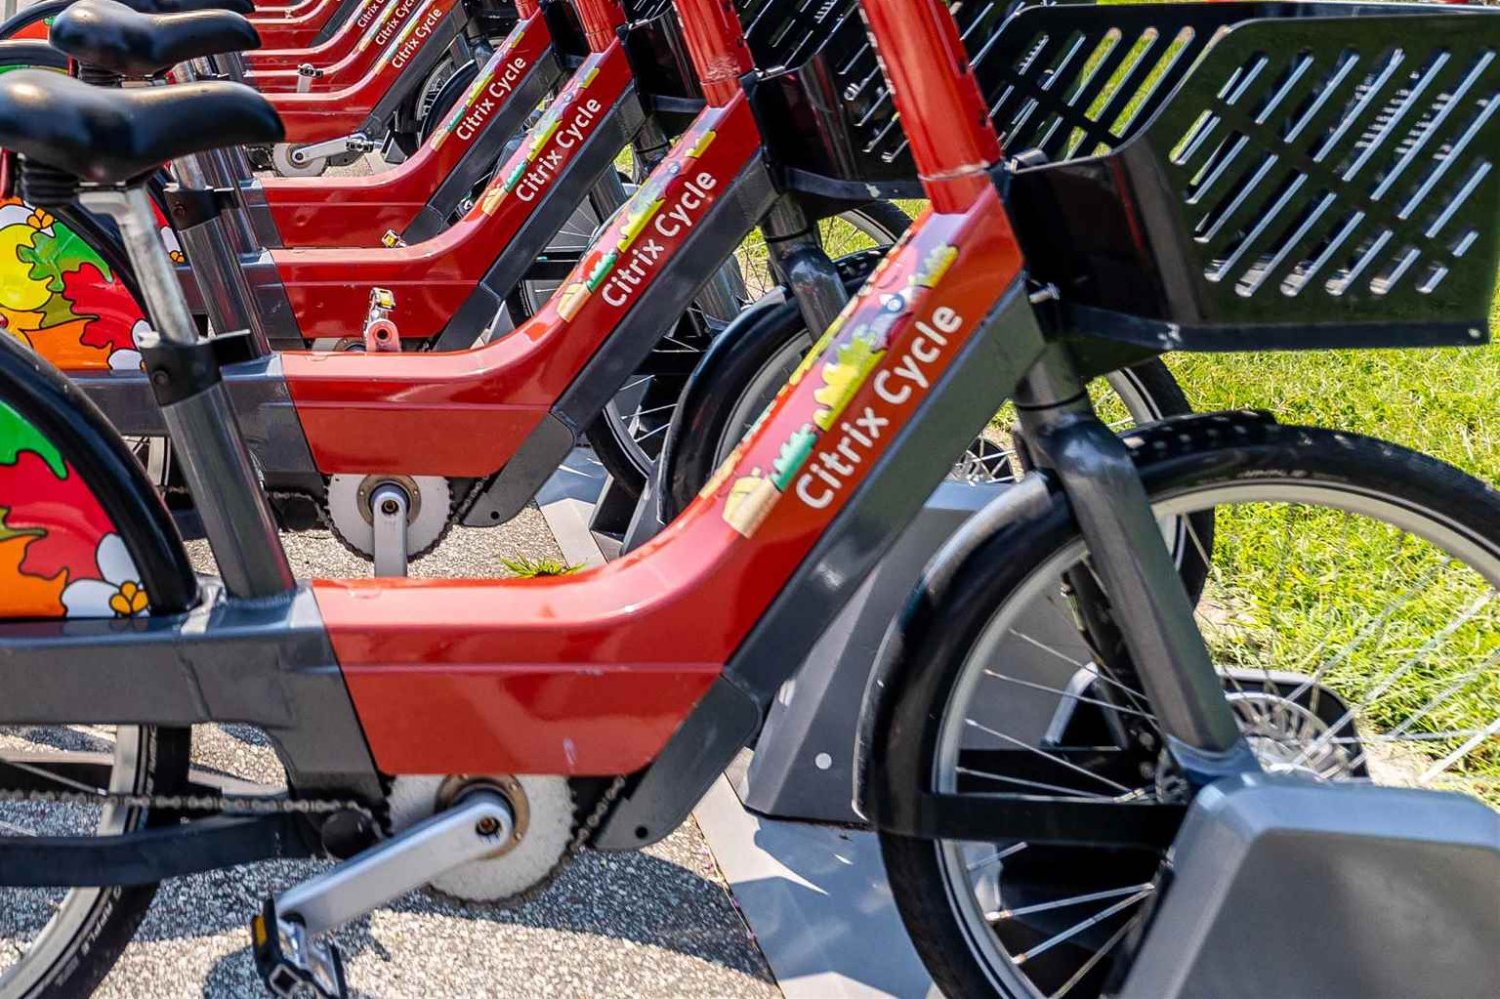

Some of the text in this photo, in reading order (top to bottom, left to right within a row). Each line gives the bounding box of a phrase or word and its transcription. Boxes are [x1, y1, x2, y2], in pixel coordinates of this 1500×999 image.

[357, 3, 379, 28] Citrix
[375, 18, 400, 45] Citrix
[392, 8, 442, 68] Citrix Cycle
[456, 57, 527, 140] Citrix Cycle
[515, 98, 602, 202] Citrix Cycle
[601, 171, 717, 307] Citrix Cycle
[795, 305, 964, 509] Citrix Cycle
